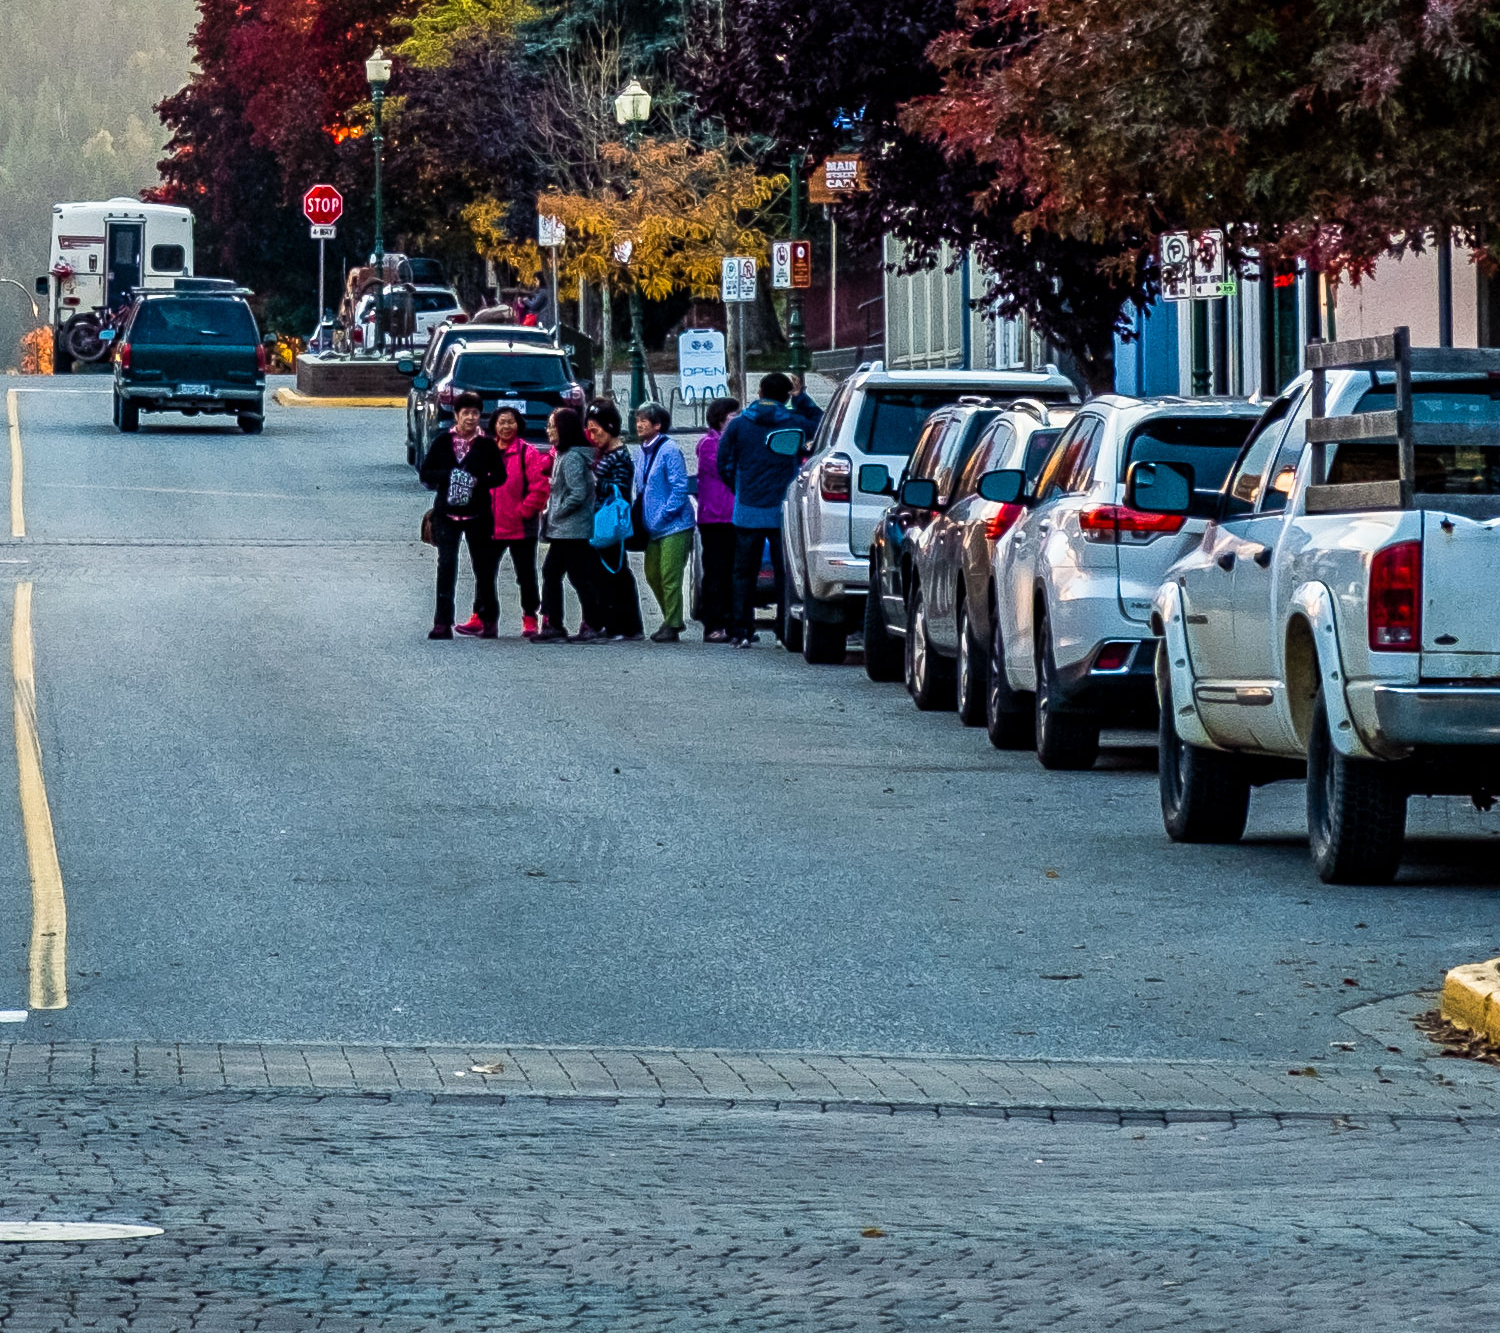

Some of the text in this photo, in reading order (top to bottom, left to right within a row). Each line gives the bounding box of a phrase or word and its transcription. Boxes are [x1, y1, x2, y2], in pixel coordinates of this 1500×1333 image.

[825, 161, 857, 172] MAIN
[307, 197, 340, 213] STOP
[682, 366, 725, 378] OPEN
